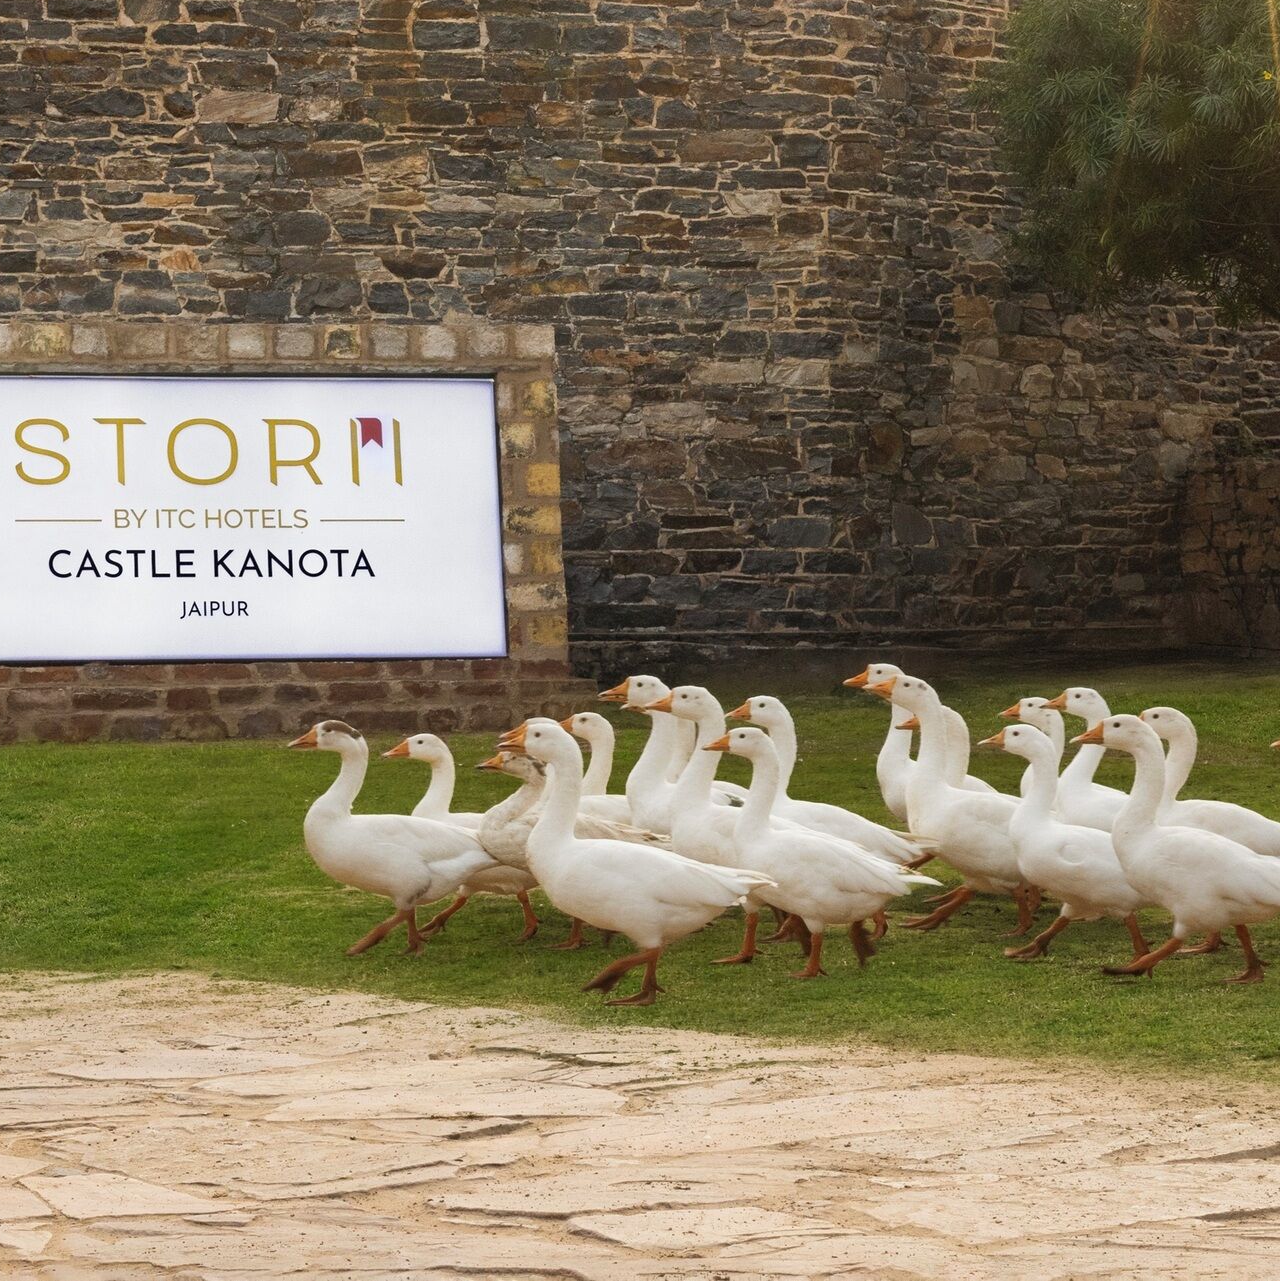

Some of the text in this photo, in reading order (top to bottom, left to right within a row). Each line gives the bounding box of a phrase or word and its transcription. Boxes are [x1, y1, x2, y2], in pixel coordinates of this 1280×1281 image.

[113, 508, 309, 529] BY ITC HOTELS
[48, 548, 376, 579] CASTLE KANOTA
[179, 600, 250, 620] JAIPUR
